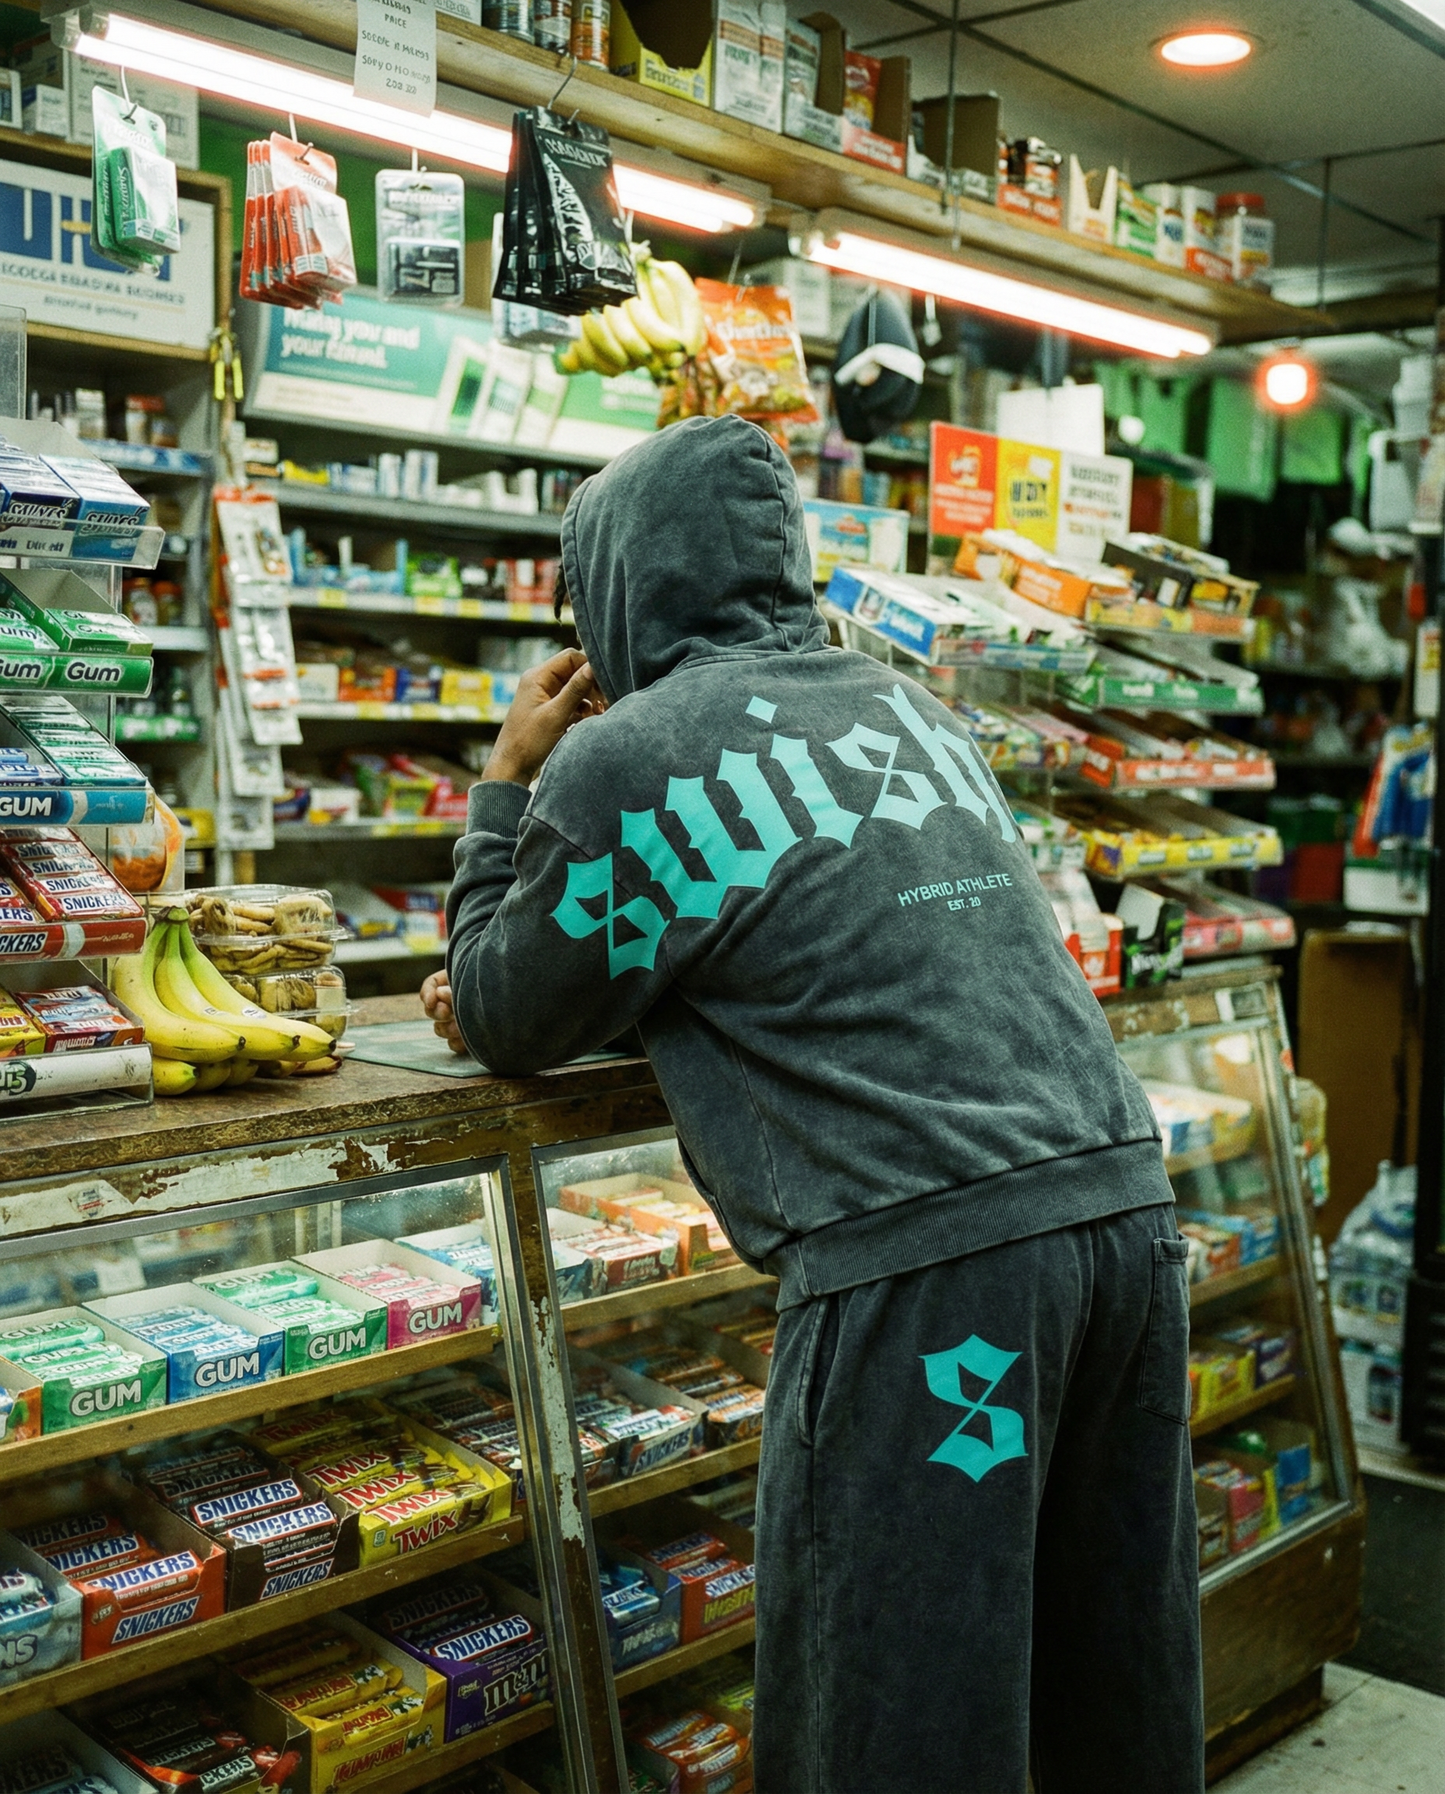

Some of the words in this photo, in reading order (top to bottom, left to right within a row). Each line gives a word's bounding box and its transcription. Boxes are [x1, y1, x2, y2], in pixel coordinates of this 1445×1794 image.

[0, 658, 41, 679] um
[66, 661, 121, 681] Gum
[0, 796, 52, 817] GUM
[63, 893, 127, 911] SNICKERS
[897, 881, 954, 907] HYBRID
[956, 873, 1013, 894] ATHLETE
[947, 898, 969, 911] EST.
[0, 907, 33, 921] ERS
[408, 1301, 463, 1334] GUM
[308, 1326, 367, 1360] GUM
[195, 1351, 260, 1388] GUM
[71, 1379, 142, 1417] GUM
[197, 1480, 299, 1523] SNICKERS
[232, 1503, 333, 1543] SNICKERS
[87, 1551, 197, 1593] SNICKERS
[262, 1560, 331, 1598] SNICKERS
[114, 1598, 199, 1643] SNICKERS
[437, 1615, 530, 1661] SNICKERS
